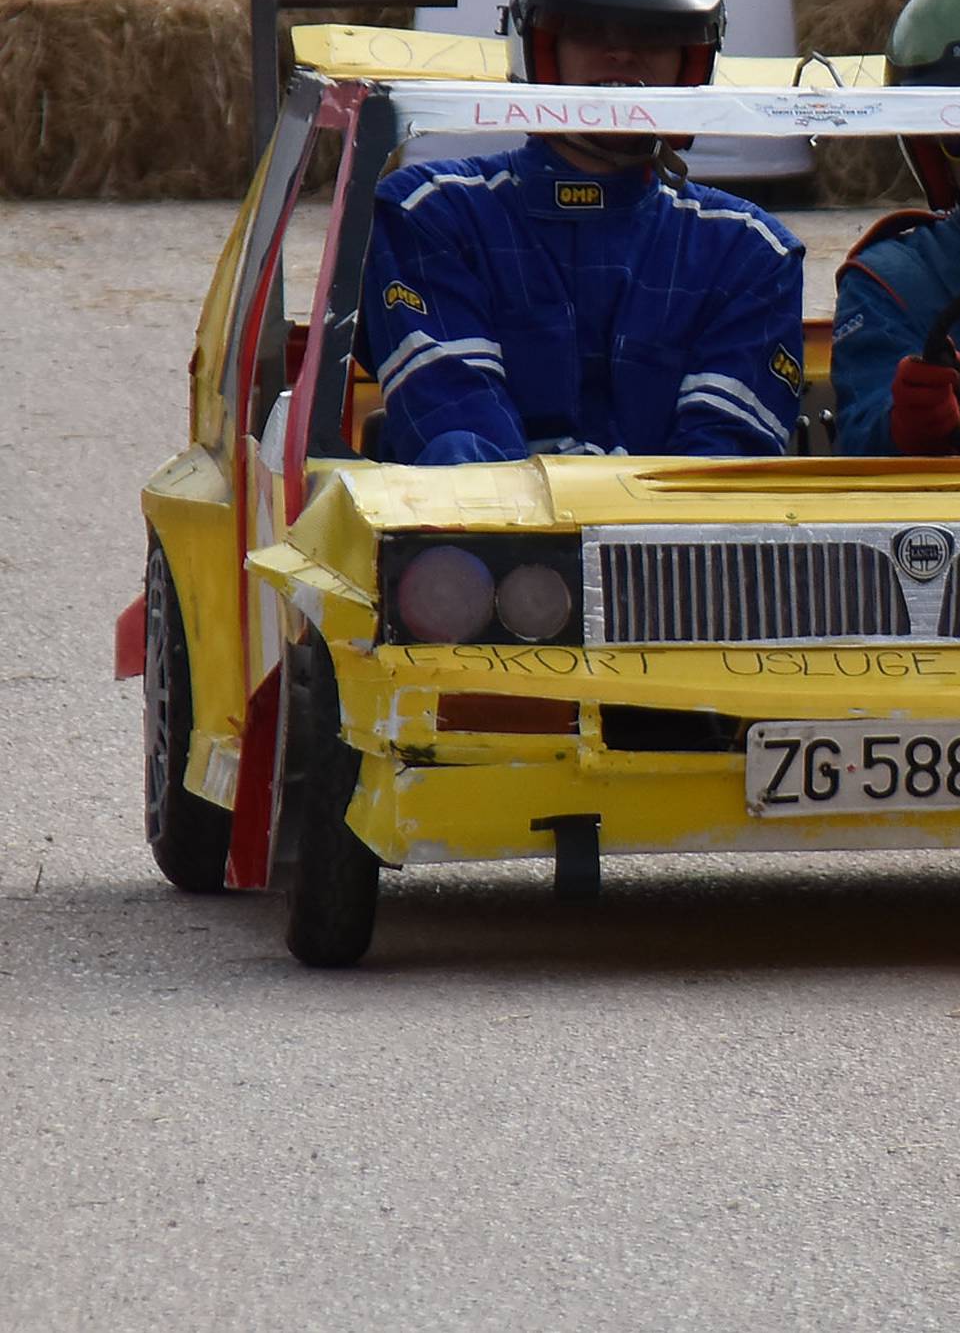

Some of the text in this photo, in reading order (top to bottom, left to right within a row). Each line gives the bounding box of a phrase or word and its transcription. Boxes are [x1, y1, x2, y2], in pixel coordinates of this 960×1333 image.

[473, 101, 656, 127] LANCIA
[560, 187, 600, 203] OMP
[386, 285, 422, 309] OMP
[403, 645, 667, 675] ESKORT
[721, 650, 957, 677] USLUGE
